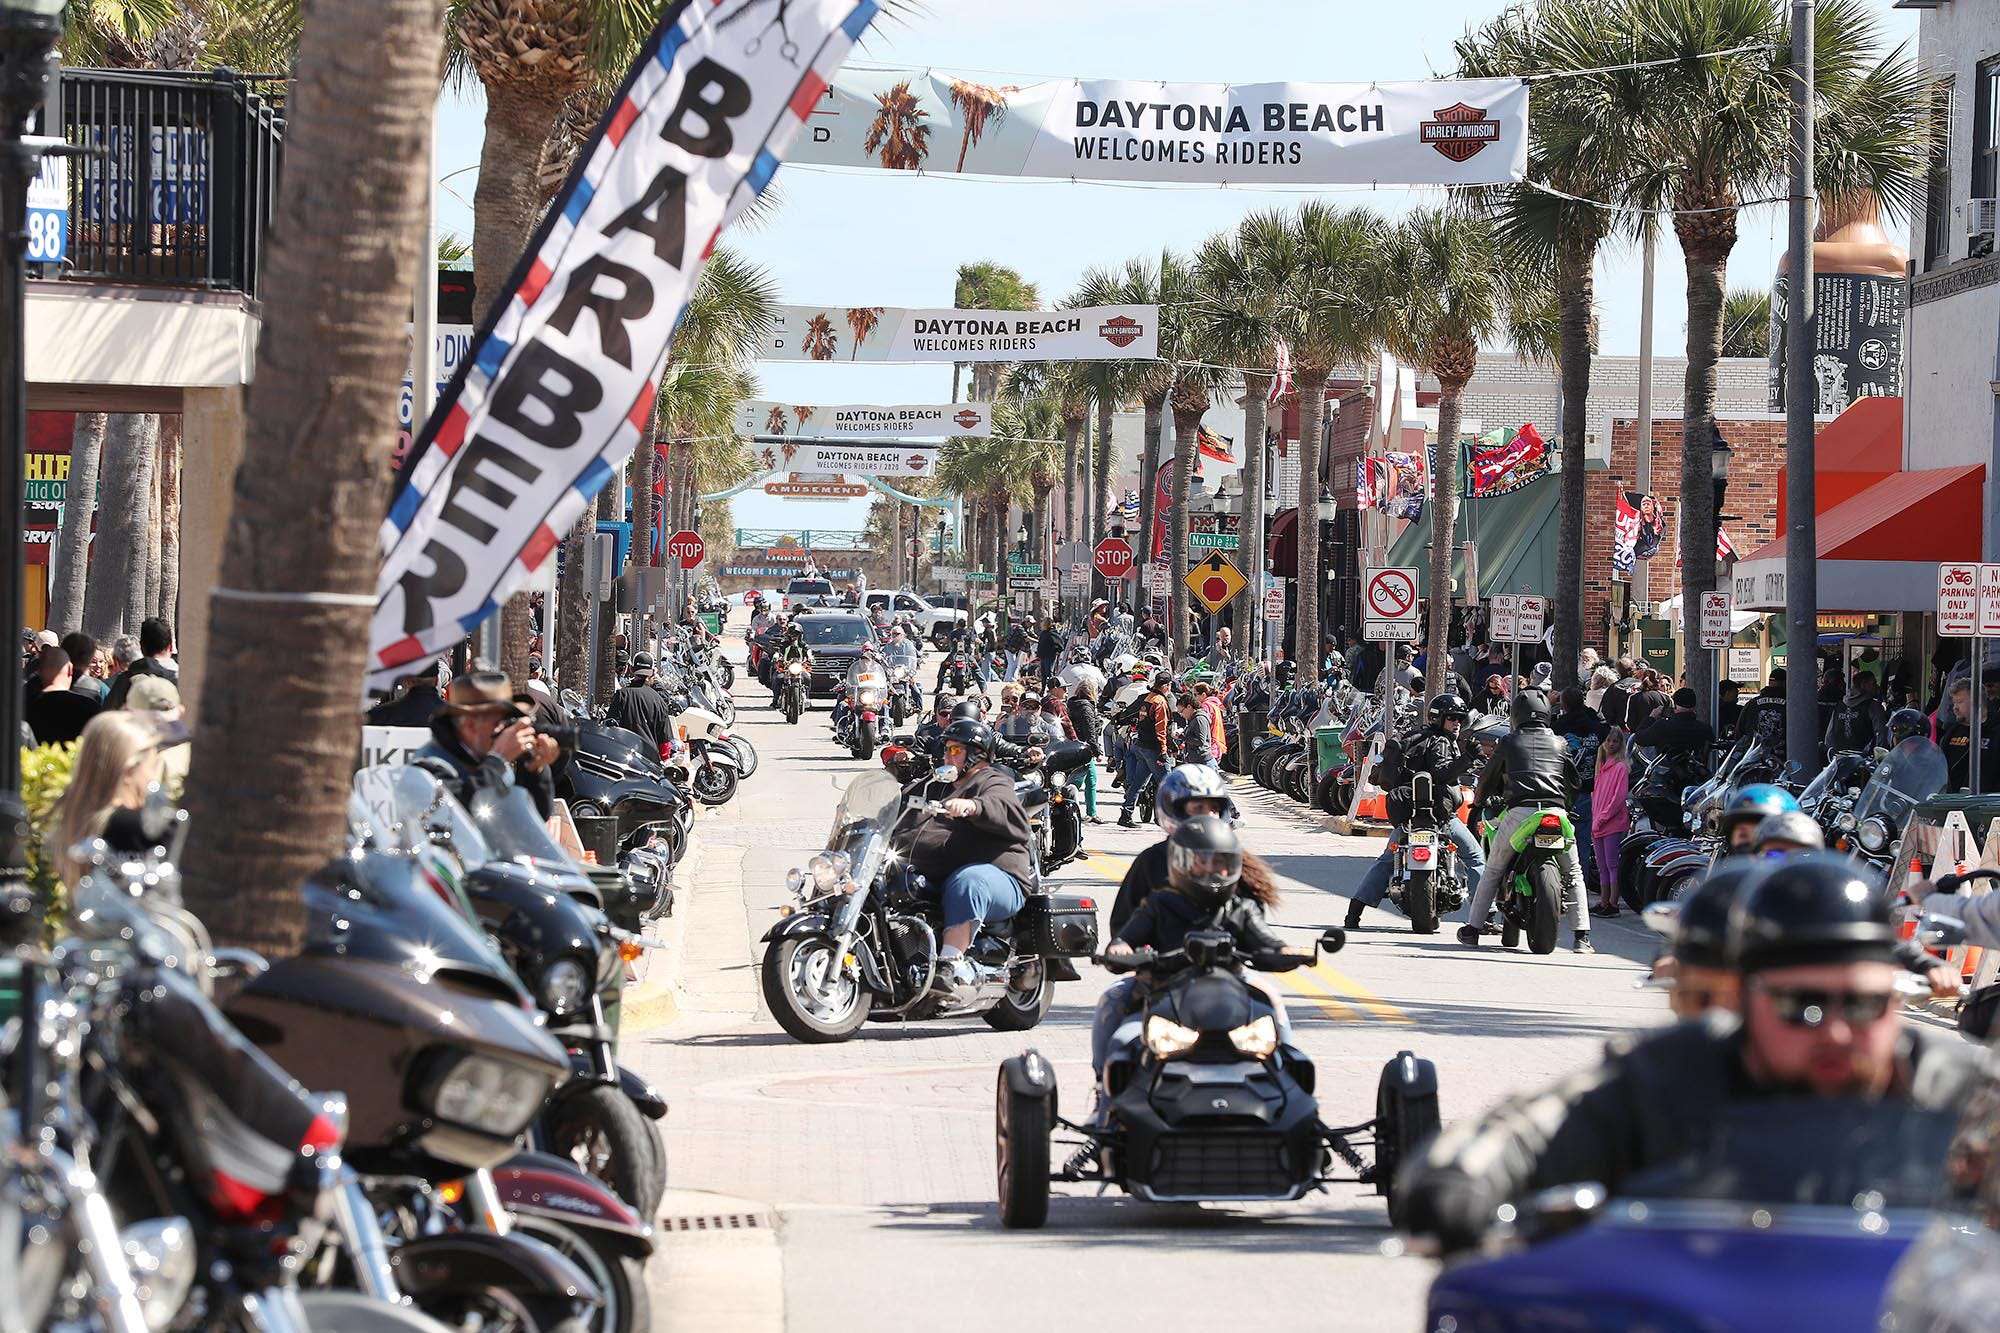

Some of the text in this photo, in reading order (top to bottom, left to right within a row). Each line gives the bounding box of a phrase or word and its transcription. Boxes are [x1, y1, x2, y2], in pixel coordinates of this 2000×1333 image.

[1076, 100, 1384, 132] DAYTONA BEACH
[1442, 108, 1479, 121] MOTOR
[813, 127, 831, 142] D
[1425, 124, 1495, 138] HARLEY-DAVIDSON
[1074, 136, 1301, 165] WELCOMES RIDERS
[1441, 141, 1479, 157] CYCLES
[774, 317, 785, 325] H
[914, 318, 1081, 336] DAYTONA BEACH
[774, 340, 784, 348] D
[913, 338, 1037, 351] WELCOMES RIDERS
[1889, 287, 1900, 398] MADE IN TENN
[836, 410, 942, 422] DAYTONA BEACH
[835, 422, 914, 432] WELCOMES RIDERS
[817, 451, 864, 461] DAYTONA
[867, 452, 900, 462] BEACH
[817, 461, 852, 470] WELCOMES
[853, 462, 877, 470] RIDERS
[885, 463, 900, 471] 2020
[769, 485, 861, 494] AMUSEMENT
[1192, 534, 1223, 546] Noble
[670, 543, 702, 558] STOP
[1096, 550, 1131, 565] STOP
[726, 567, 764, 575] WELCOME
[1940, 588, 1976, 597] PARKING
[1499, 597, 1510, 607] NO
[1947, 600, 1968, 609] ONLY
[1493, 607, 1516, 617] PARKING
[1703, 609, 1728, 617] PARKING
[1940, 612, 1975, 620] 10AM-2AM
[1709, 619, 1722, 627] ONLY
[1816, 614, 1864, 629] ULL MOON
[1497, 624, 1510, 632] TIME
[1370, 630, 1412, 638] SIDEWALK
